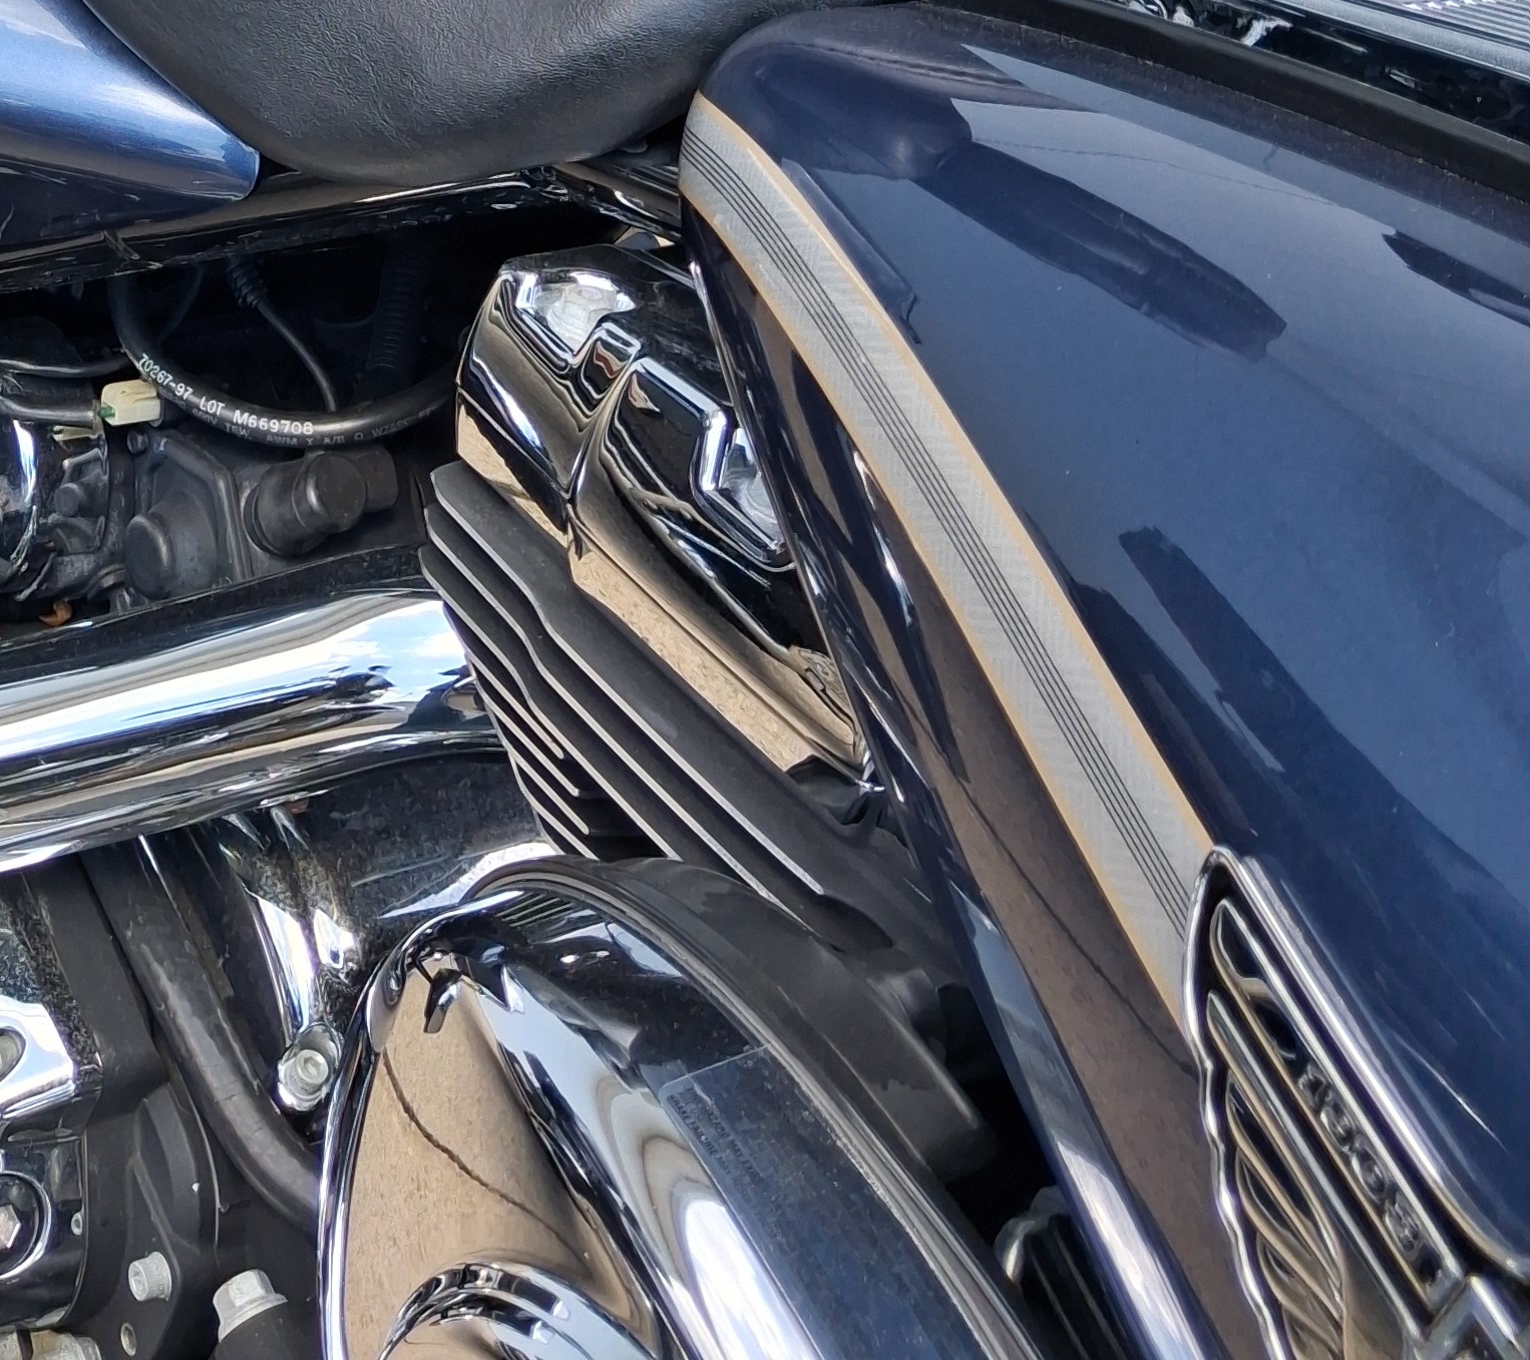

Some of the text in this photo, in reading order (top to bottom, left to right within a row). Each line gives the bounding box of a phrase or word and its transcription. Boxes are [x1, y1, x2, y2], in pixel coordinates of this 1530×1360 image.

[138, 353, 194, 400] 70267-97
[199, 396, 225, 416] LOT
[233, 409, 315, 435] M669708
